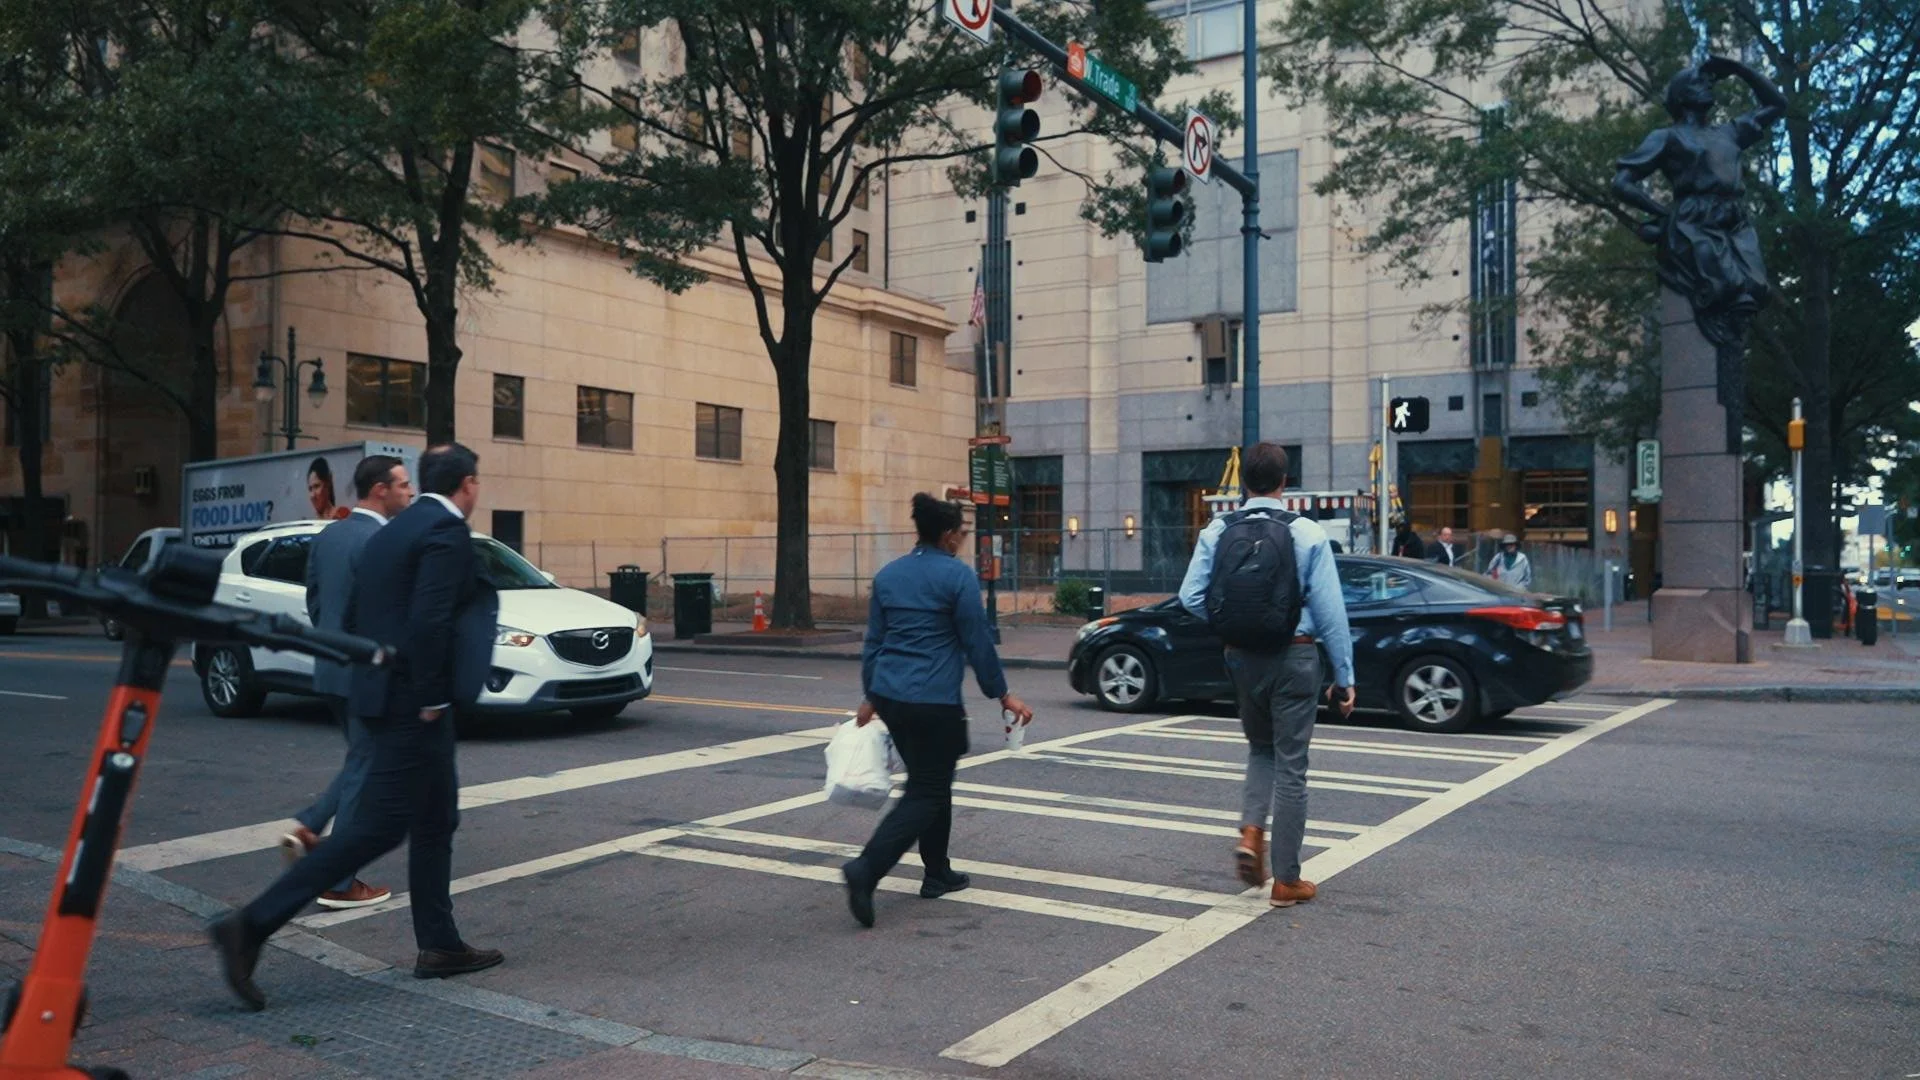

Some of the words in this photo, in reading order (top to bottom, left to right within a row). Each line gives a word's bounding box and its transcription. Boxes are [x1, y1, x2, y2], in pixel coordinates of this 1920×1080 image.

[1095, 64, 1119, 100] Trade
[193, 487, 217, 503] EGGS
[218, 484, 245, 499] FROM
[193, 505, 230, 528] FOOD
[232, 500, 274, 525] LION?
